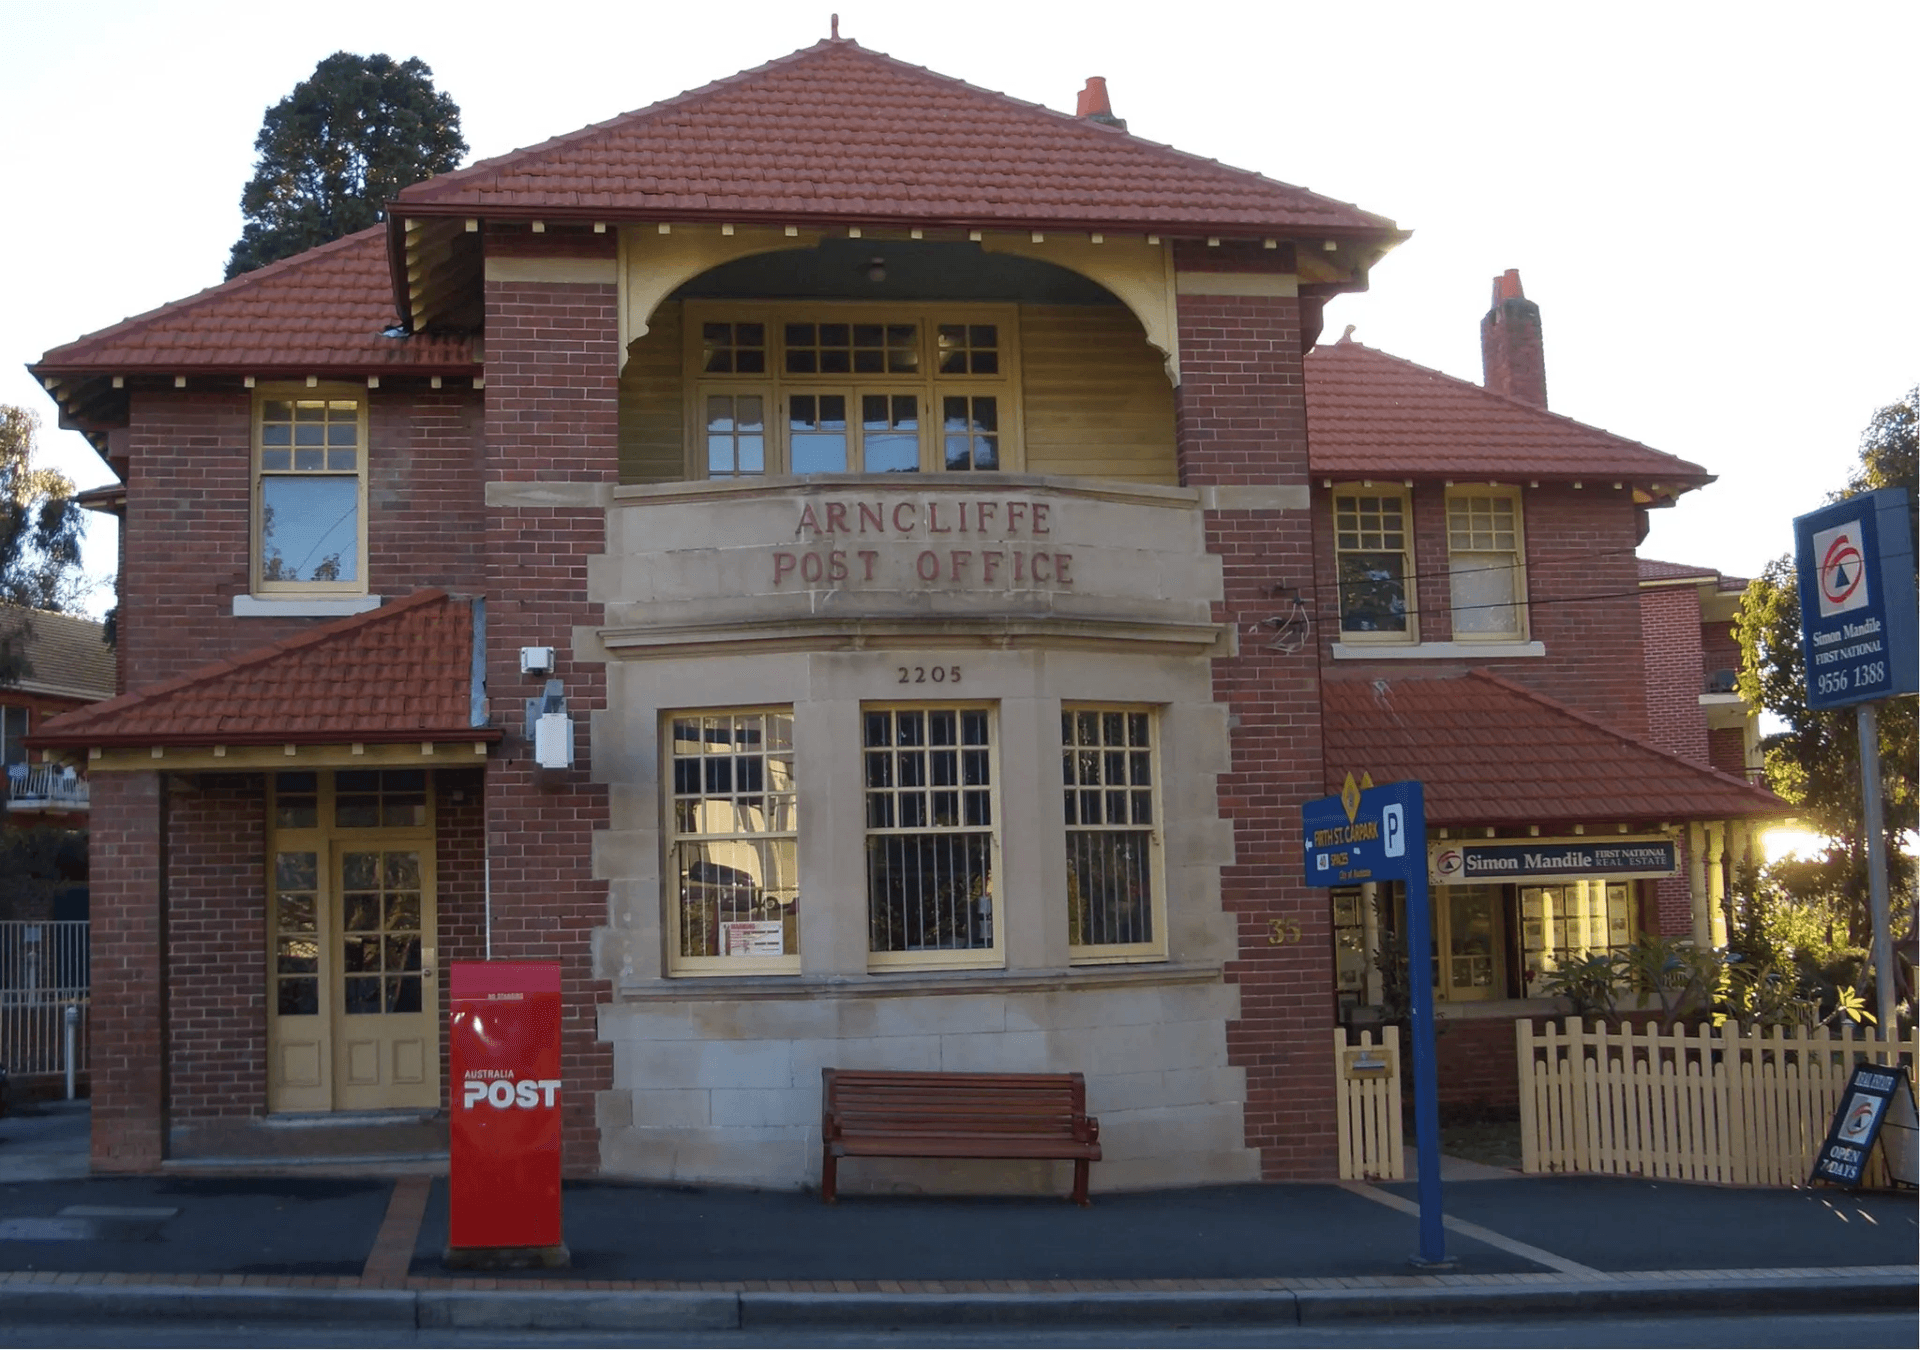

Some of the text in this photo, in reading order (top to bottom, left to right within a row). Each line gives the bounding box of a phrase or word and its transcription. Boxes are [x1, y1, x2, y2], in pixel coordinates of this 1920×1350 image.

[795, 501, 1050, 535] ARNCLIFFE
[772, 550, 1074, 585] POST OFFICE
[1812, 617, 1882, 647] Simon Mandile
[1815, 640, 1883, 666] FIRST NATIONAL
[898, 666, 962, 684] 2205
[1817, 661, 1884, 695] 9556 1388
[1466, 852, 1592, 870] Simon Mandile
[1595, 848, 1666, 859] FIRST NATIONAL
[1595, 856, 1668, 867] REAL ESTATE
[1269, 919, 1301, 944] 35
[465, 1069, 514, 1079] AUSTRALIA
[464, 1080, 562, 1109] POST
[1829, 1145, 1861, 1163] OPEN
